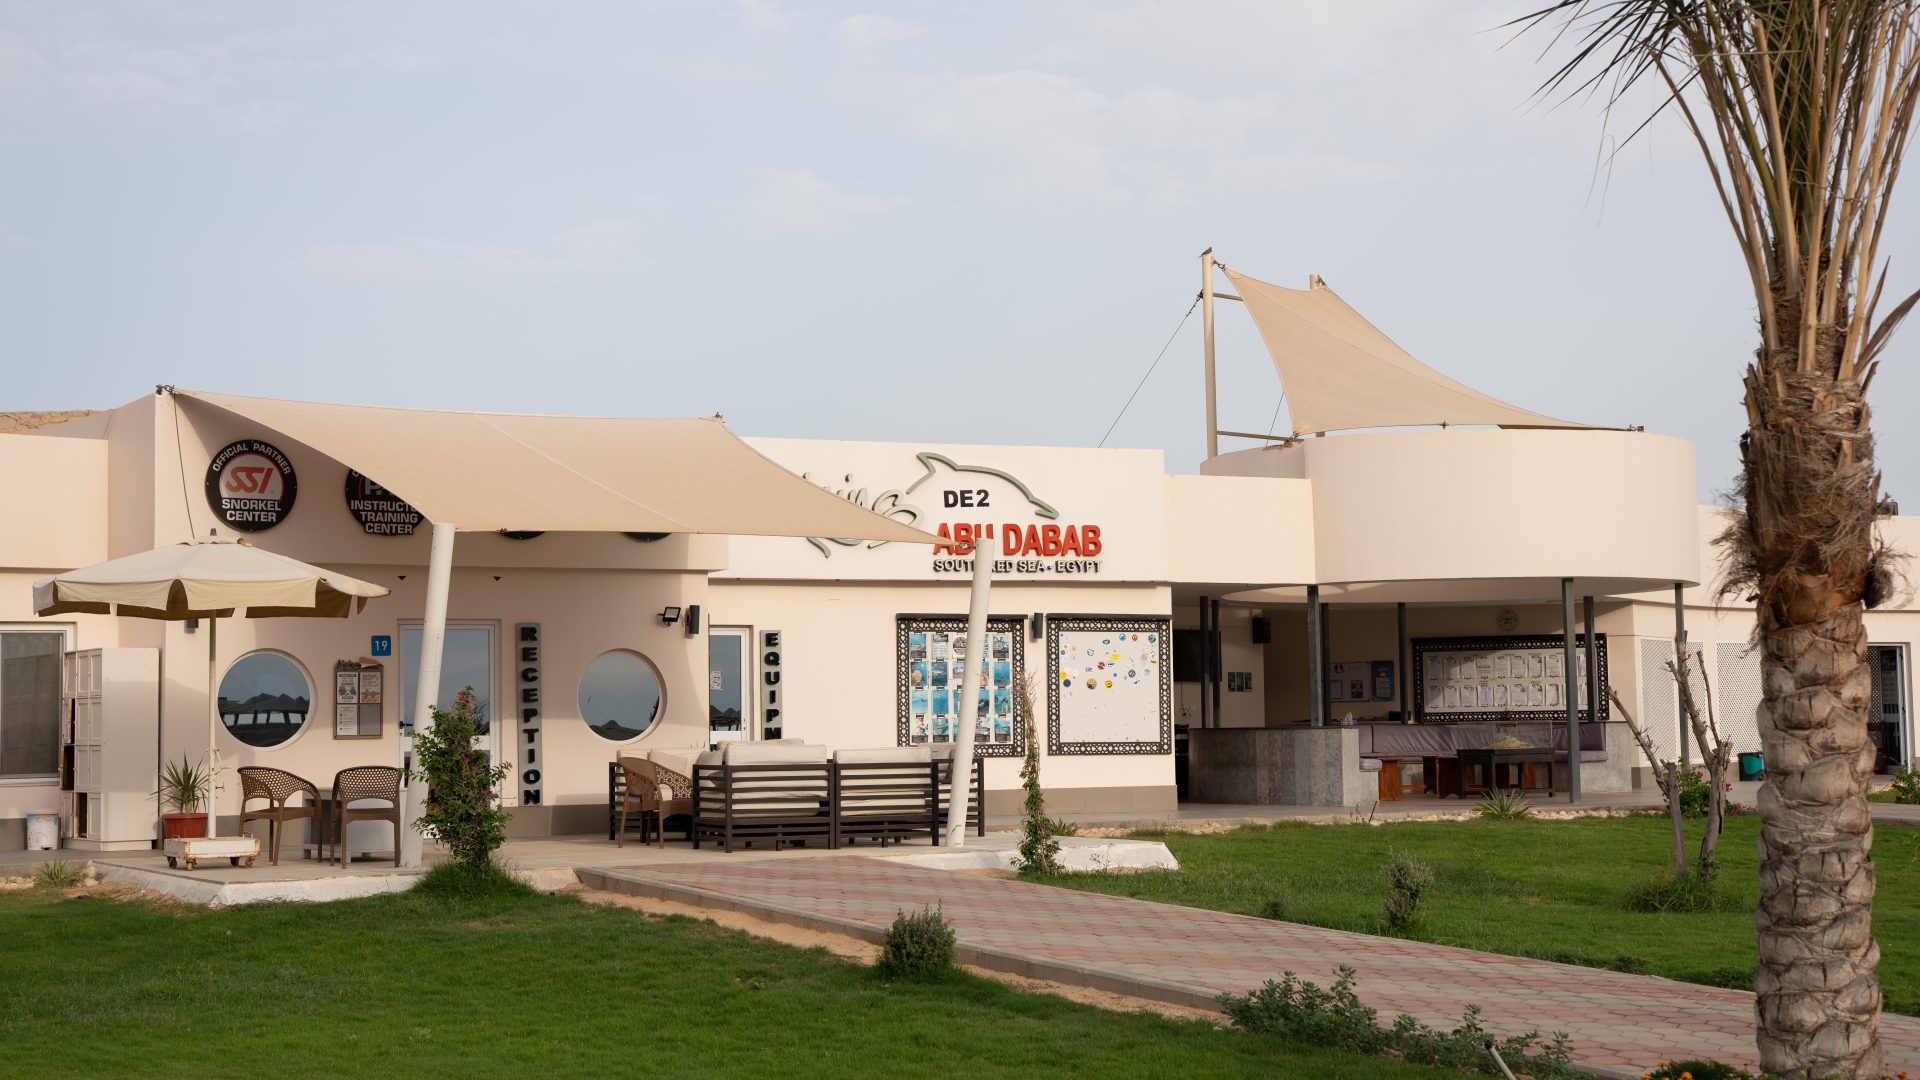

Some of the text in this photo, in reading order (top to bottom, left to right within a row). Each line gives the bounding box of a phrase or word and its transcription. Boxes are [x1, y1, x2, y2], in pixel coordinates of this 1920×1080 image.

[213, 442, 291, 475] OFFICIAL PARTNER
[226, 466, 274, 494] SSI
[222, 498, 281, 511] SNORKEL
[943, 489, 990, 508] DE2
[226, 510, 277, 522] CENTER
[360, 511, 418, 523] TRAINING
[365, 523, 413, 534] CENTER
[1002, 523, 1103, 557] DABAB
[933, 558, 975, 572] SOUT
[1016, 559, 1045, 573] SEA
[1055, 560, 1103, 573] EGYPT
[374, 640, 388, 651] 19
[763, 632, 782, 740] EQUIPM
[520, 626, 541, 805] RECEPTION
